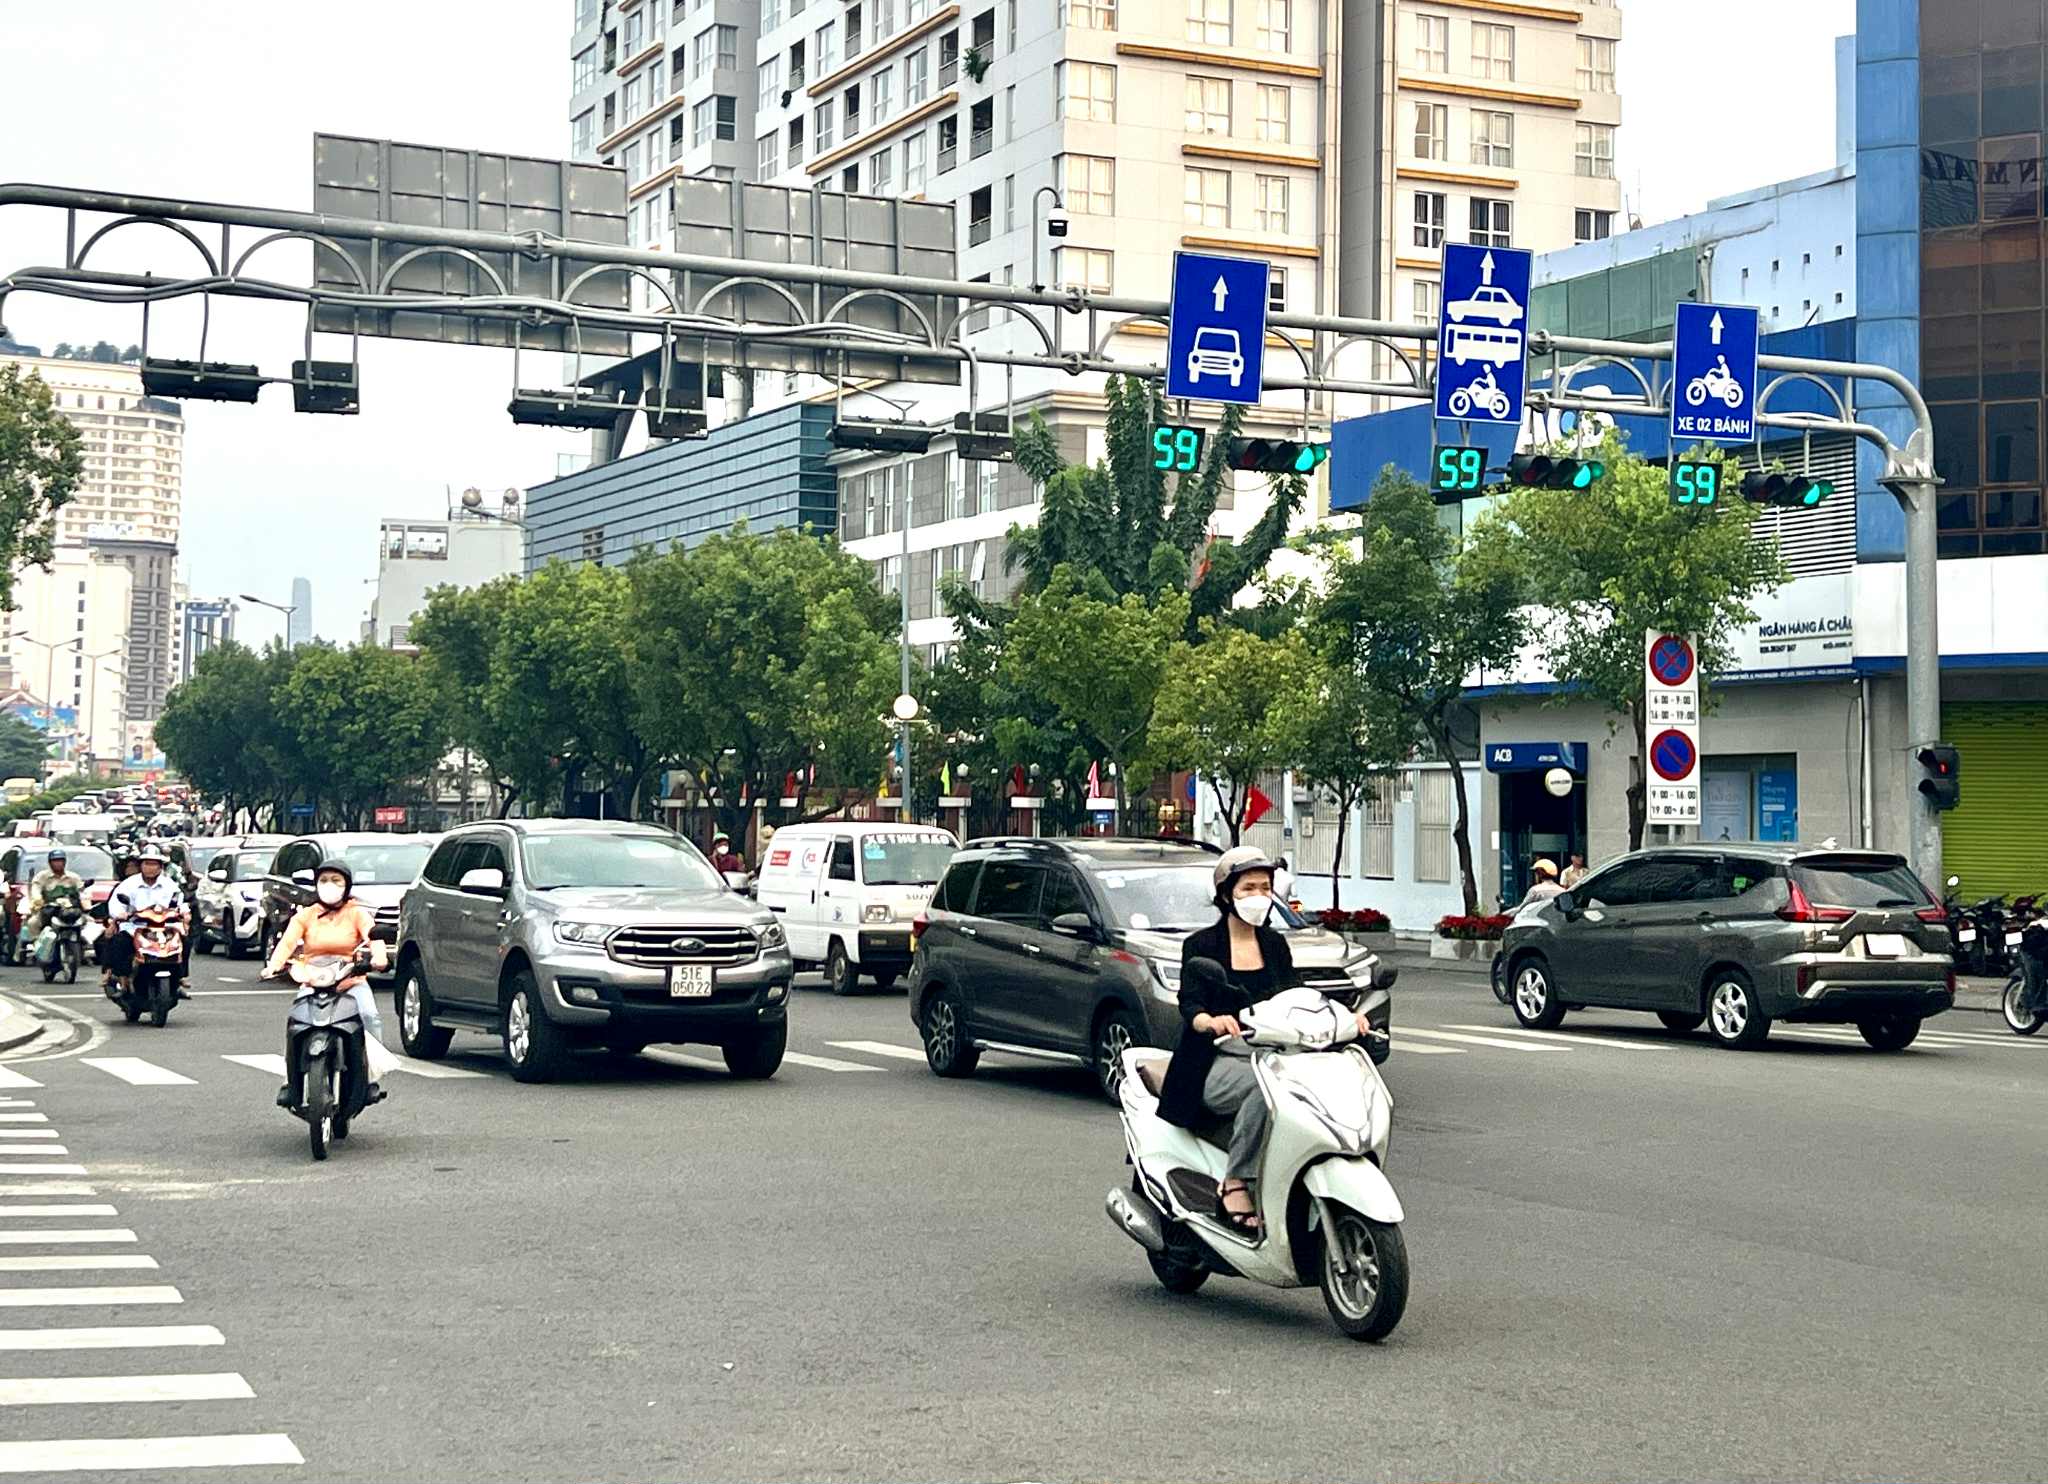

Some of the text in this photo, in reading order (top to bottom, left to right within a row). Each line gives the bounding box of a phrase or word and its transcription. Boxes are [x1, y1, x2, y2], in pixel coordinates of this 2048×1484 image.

[1678, 416, 1750, 434] XE 02 BÁNH
[1153, 427, 1198, 470] 59
[1440, 448, 1481, 490] 59
[1676, 465, 1715, 504] 59
[1760, 622, 1787, 636] NGÂN
[1494, 748, 1513, 762] ACB
